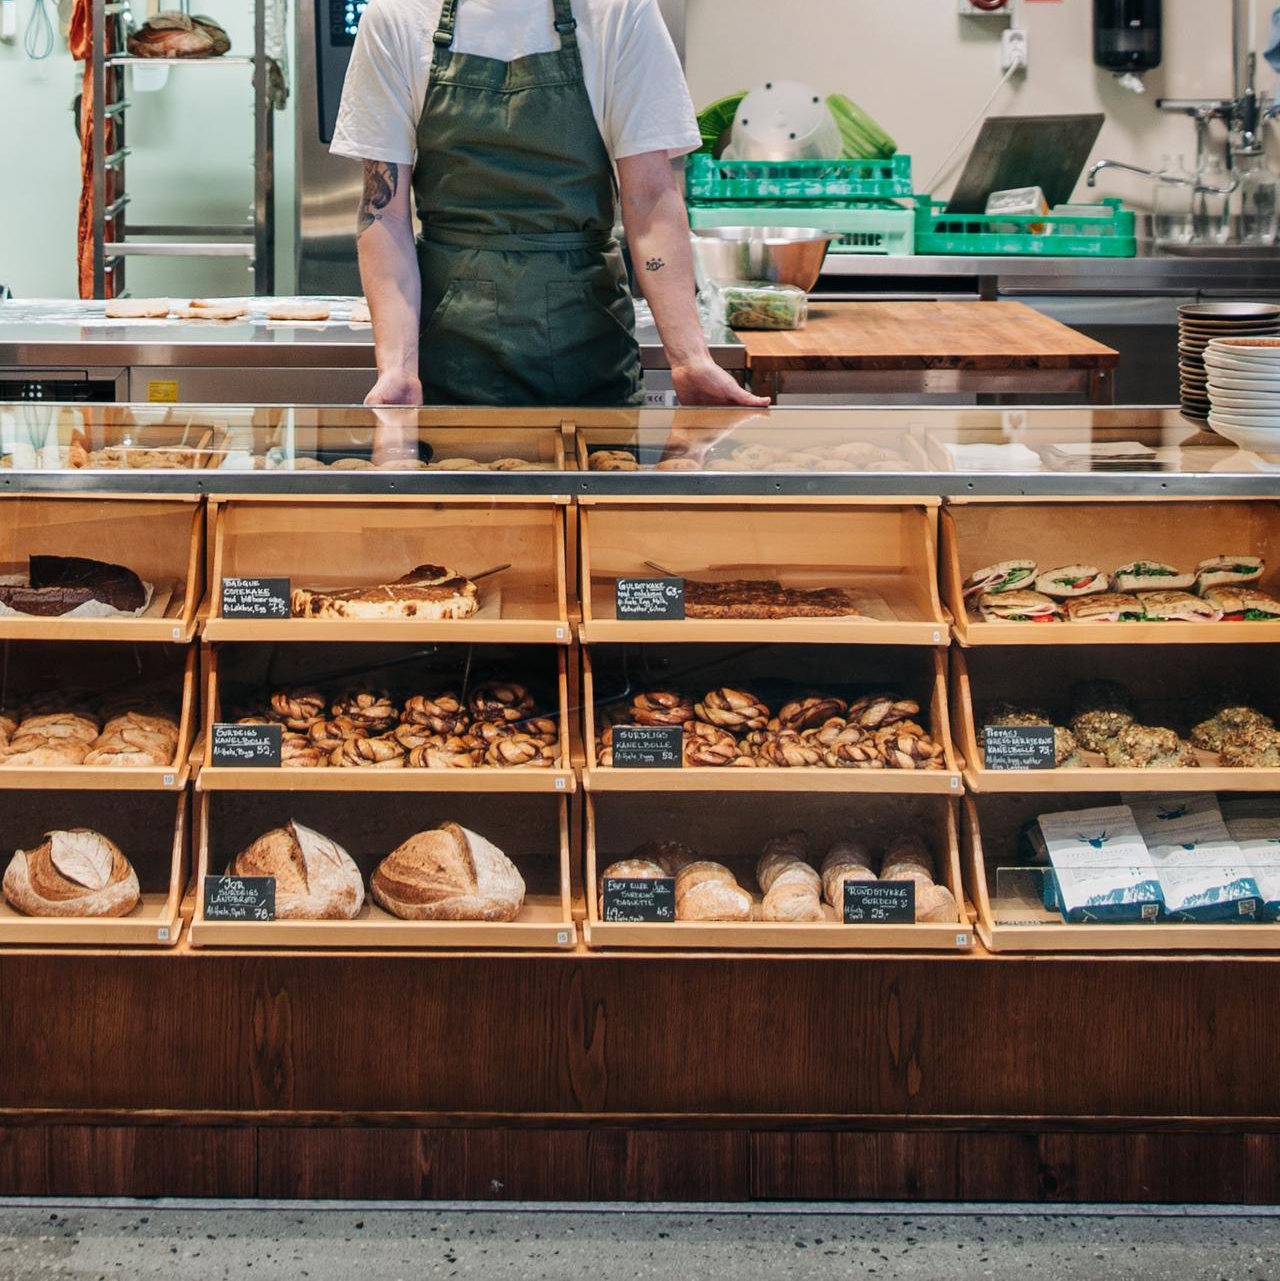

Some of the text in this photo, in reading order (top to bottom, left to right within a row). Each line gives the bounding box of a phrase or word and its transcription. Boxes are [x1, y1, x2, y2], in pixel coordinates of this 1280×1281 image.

[223, 588, 270, 596] OSTEKAKE
[216, 728, 257, 737] SURDEIGS
[620, 731, 669, 739] SURDEIGS
[215, 737, 271, 746] KANELBOLLE
[616, 741, 673, 749] KANELBOLLE
[256, 745, 276, 757] 52,-
[987, 745, 1036, 754] KANELBOLLE
[218, 889, 259, 897] SURDEIGS
[210, 894, 257, 904] LANDBRØD
[862, 898, 898, 906] SURDEIG
[254, 908, 274, 921] 78,-
[870, 908, 889, 921] 25,-
